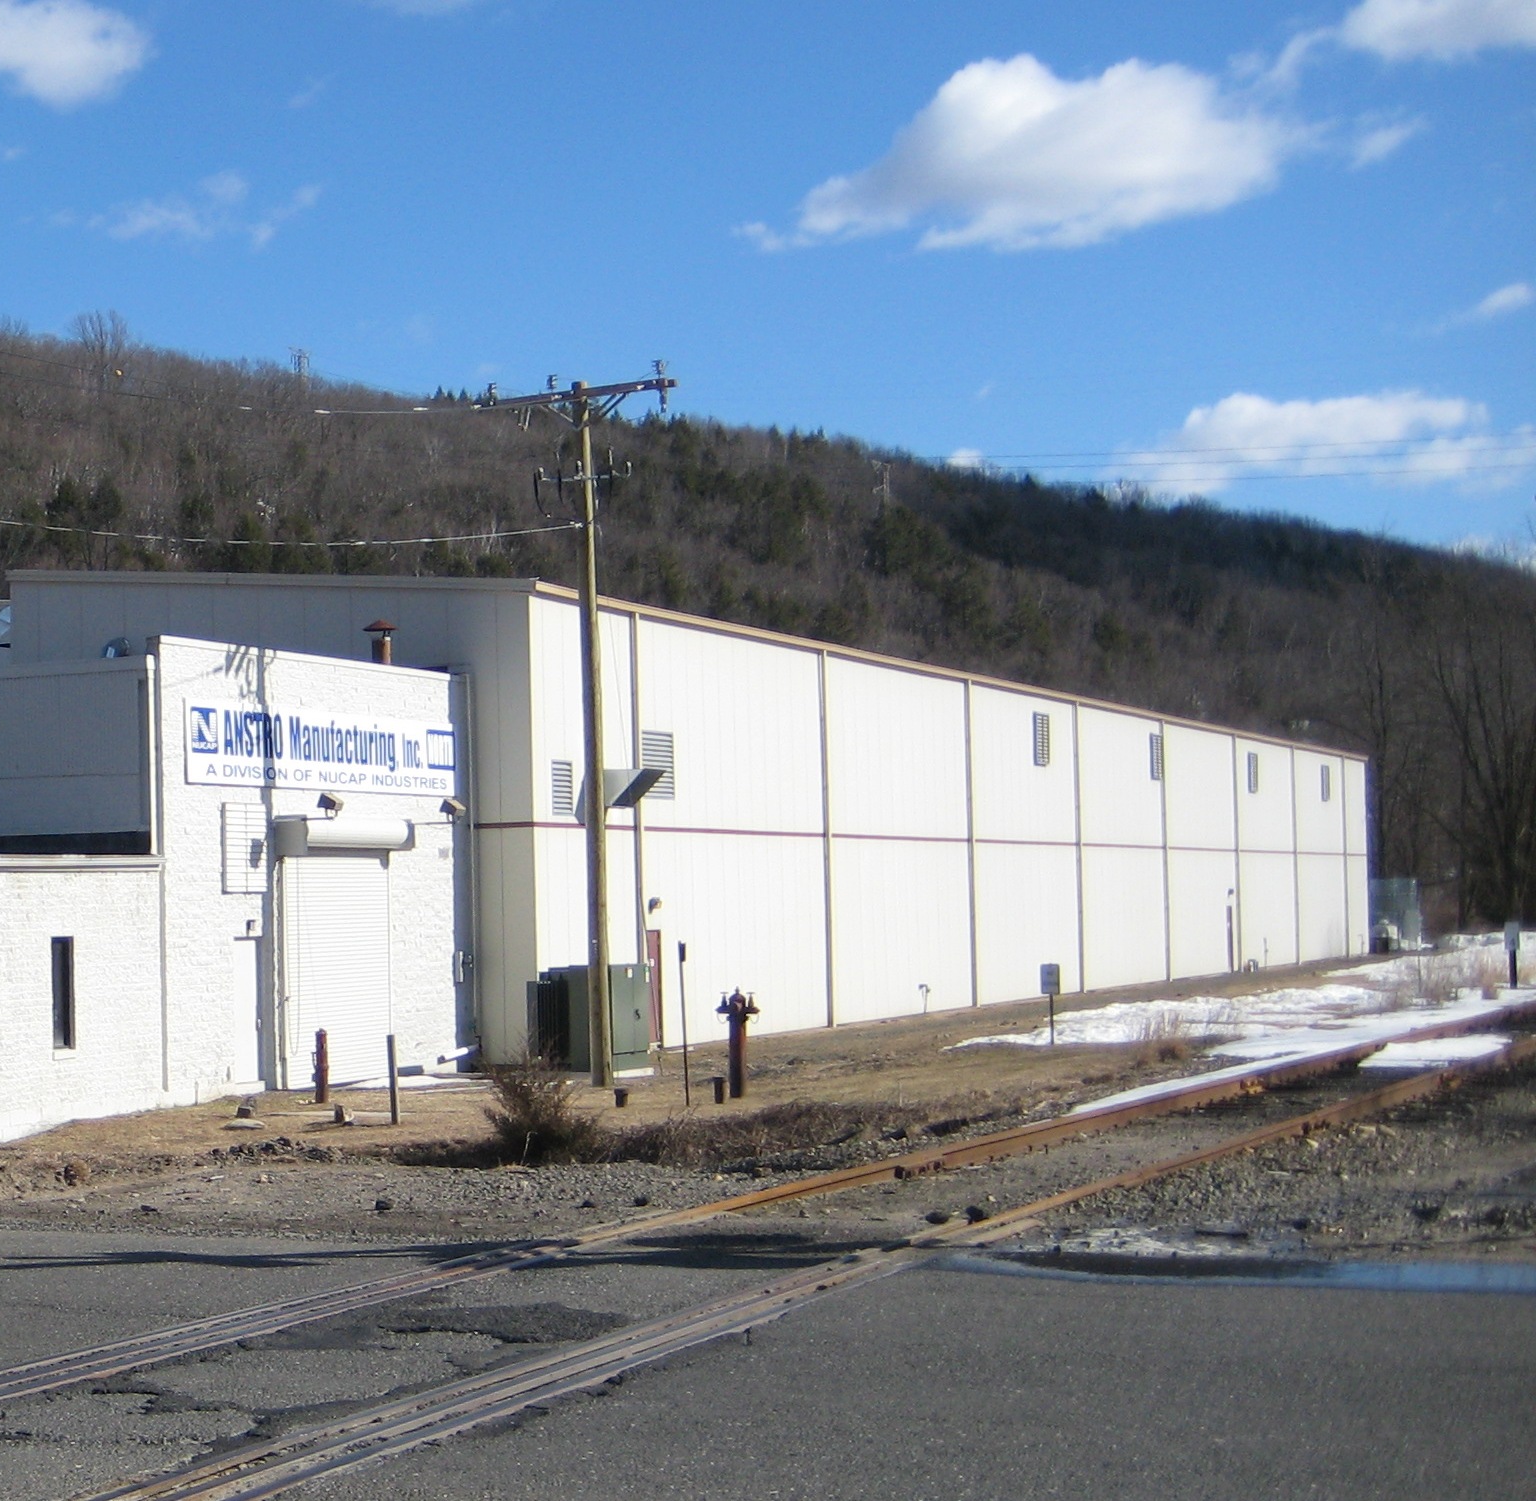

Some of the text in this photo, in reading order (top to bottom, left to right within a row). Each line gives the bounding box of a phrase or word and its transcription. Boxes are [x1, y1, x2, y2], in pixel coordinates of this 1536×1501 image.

[192, 741, 218, 750] NUCAP
[224, 709, 284, 758] ANSTRO
[402, 733, 424, 769] Inc.
[206, 763, 448, 790] A DIVISION OF NUCAP INDUSTRIES
